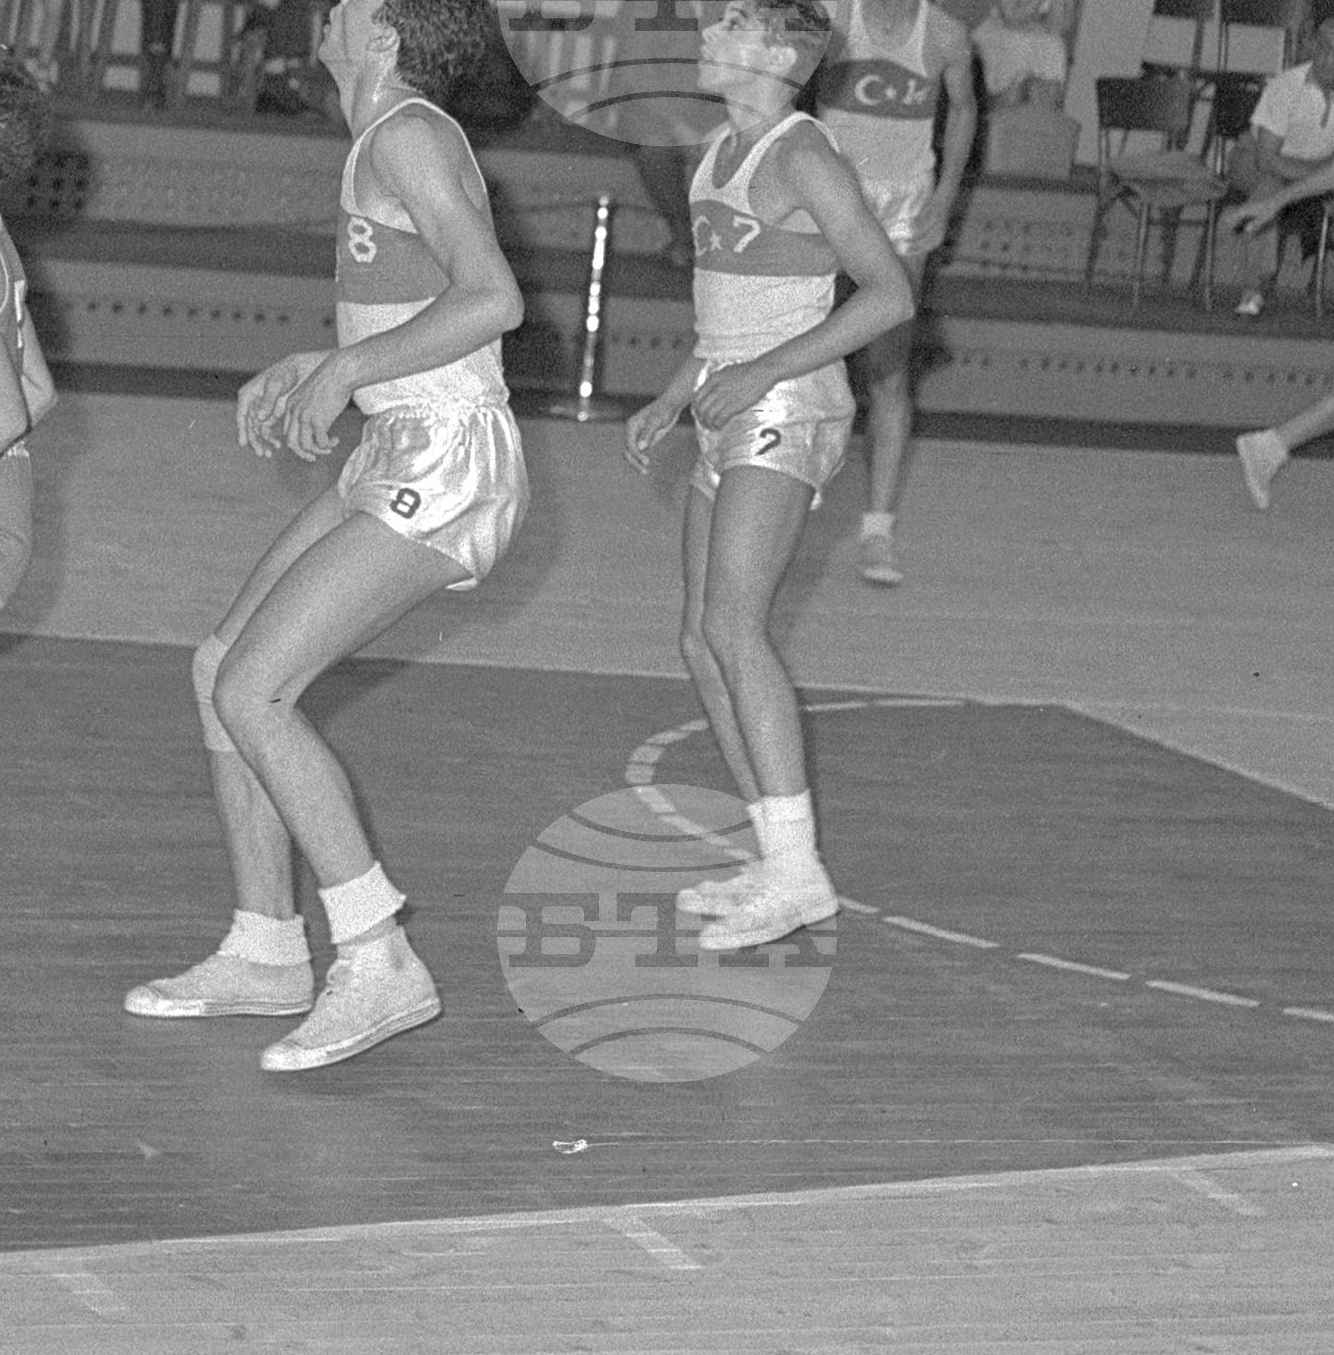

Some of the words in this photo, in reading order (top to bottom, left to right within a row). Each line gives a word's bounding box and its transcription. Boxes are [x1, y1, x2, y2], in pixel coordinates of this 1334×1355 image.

[347, 216, 377, 263] 8
[733, 215, 761, 253] 7
[389, 487, 421, 519] 8
